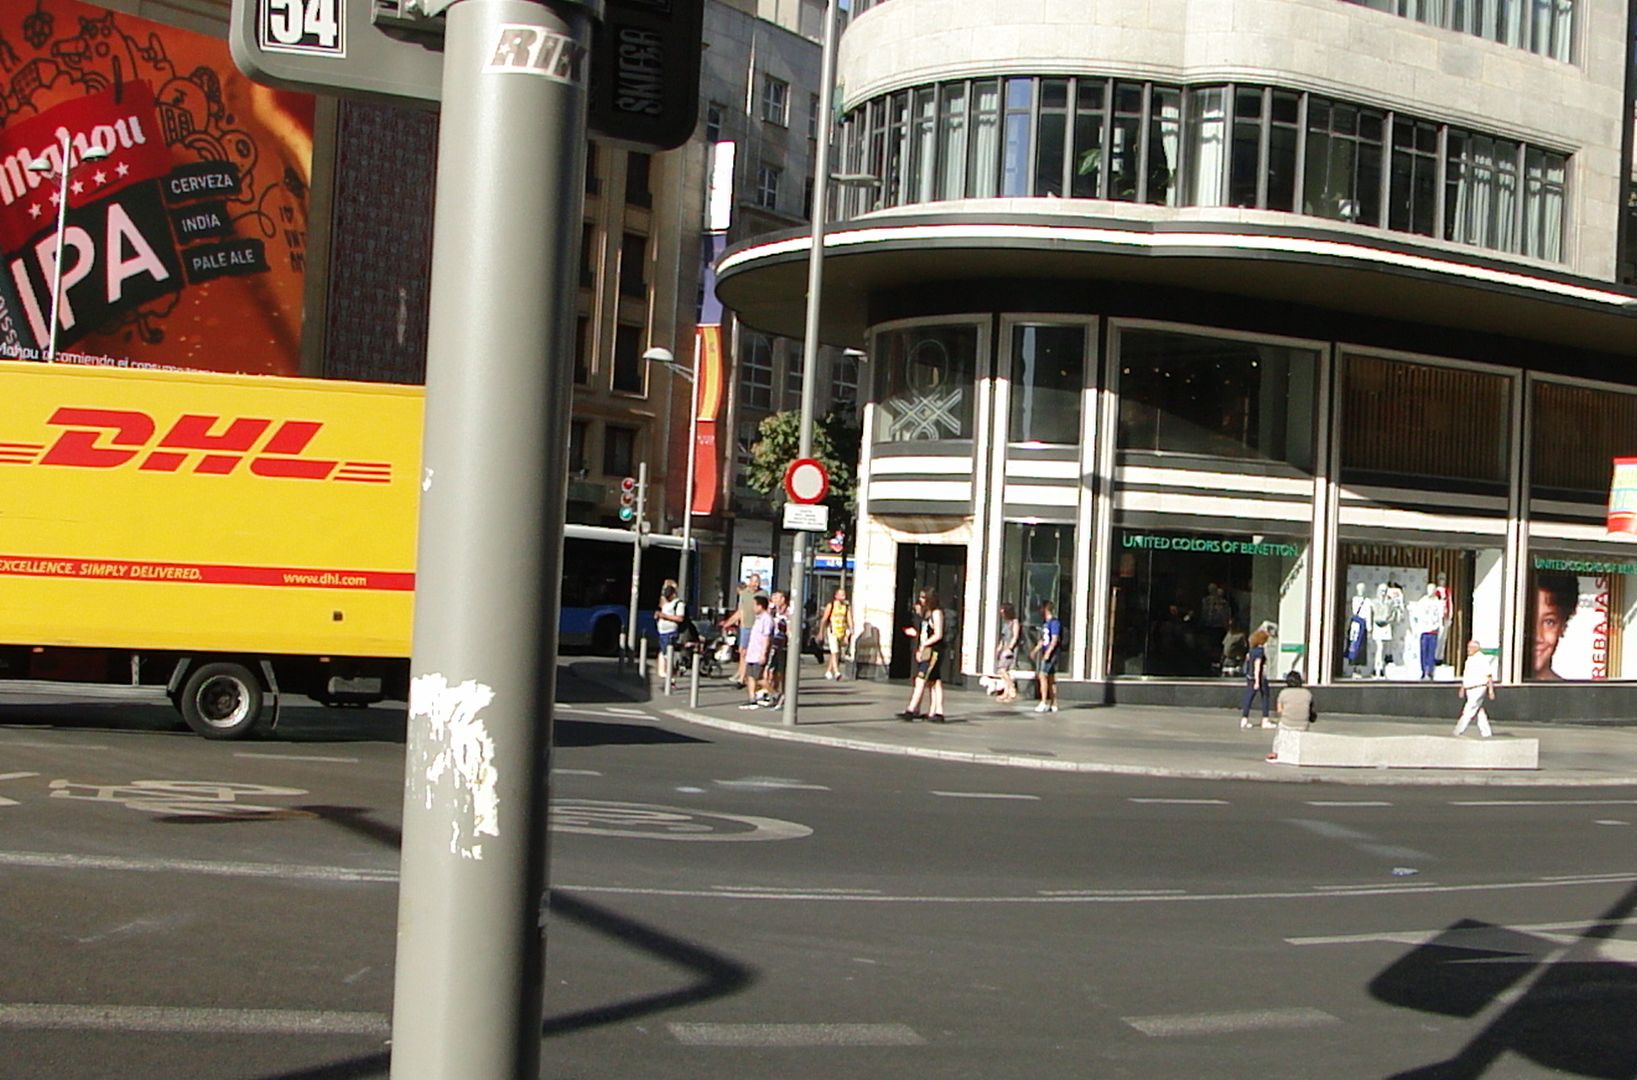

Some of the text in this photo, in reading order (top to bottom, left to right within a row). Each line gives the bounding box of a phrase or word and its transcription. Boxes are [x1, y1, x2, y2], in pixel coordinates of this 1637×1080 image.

[170, 173, 234, 194] CERVEZA
[182, 213, 221, 232] INDIA
[192, 248, 255, 271] PALE ALE
[11, 202, 170, 350] IPA
[38, 406, 338, 480] DHL
[1122, 534, 1170, 549] UNITED
[1171, 536, 1220, 553] COLORS
[1221, 541, 1239, 553] OF
[80, 563, 127, 579] SIMPLY
[130, 565, 203, 581] DELIVERED.
[283, 572, 367, 587] www.dhl.com
[1592, 576, 1609, 680] REBAJAS
